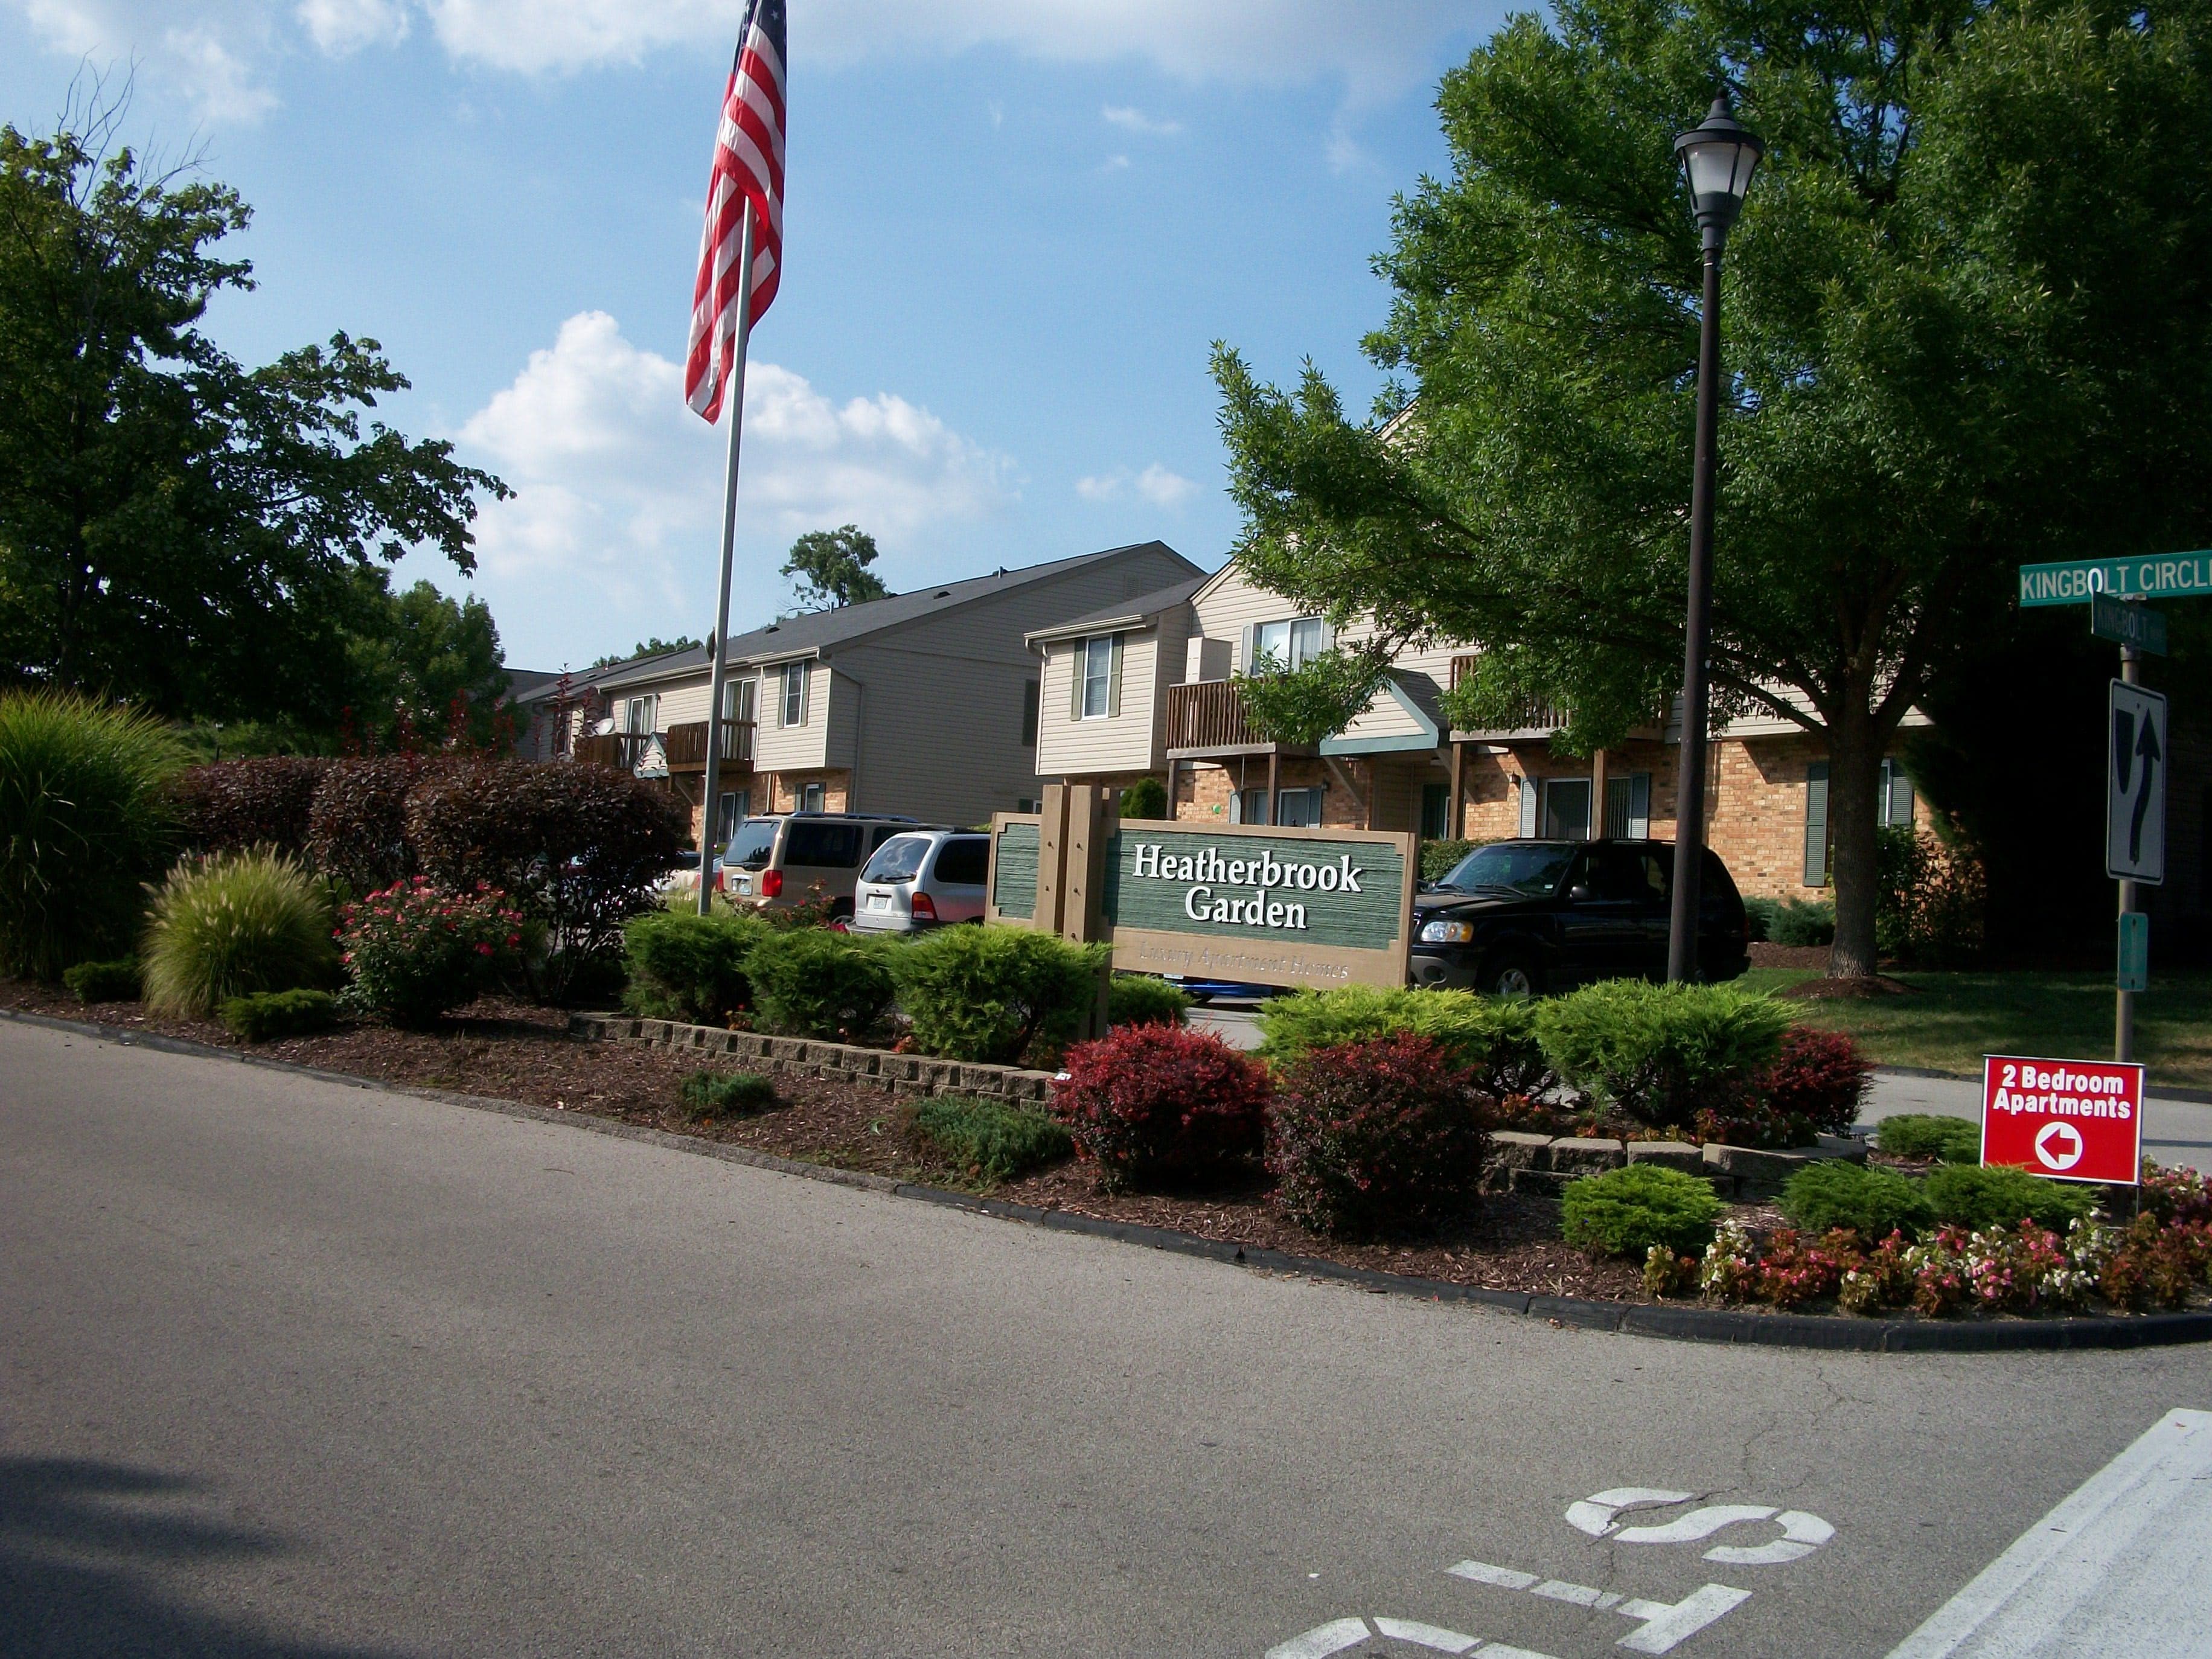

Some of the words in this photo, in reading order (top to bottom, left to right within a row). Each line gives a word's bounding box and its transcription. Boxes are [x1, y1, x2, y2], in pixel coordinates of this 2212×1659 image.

[2021, 566, 2129, 599] KINGBOLT
[2098, 602, 2148, 644] KINGBOLT
[1133, 843, 1363, 893] Heatherbrook
[1184, 886, 1307, 929] Garden
[1140, 941, 1194, 969] Luxury
[1198, 947, 1286, 973] Apartment
[1290, 955, 1349, 979] Homes
[2001, 1064, 2016, 1087] 2
[2022, 1066, 2123, 1094] Bedroom
[1993, 1088, 2131, 1119] Apartments
